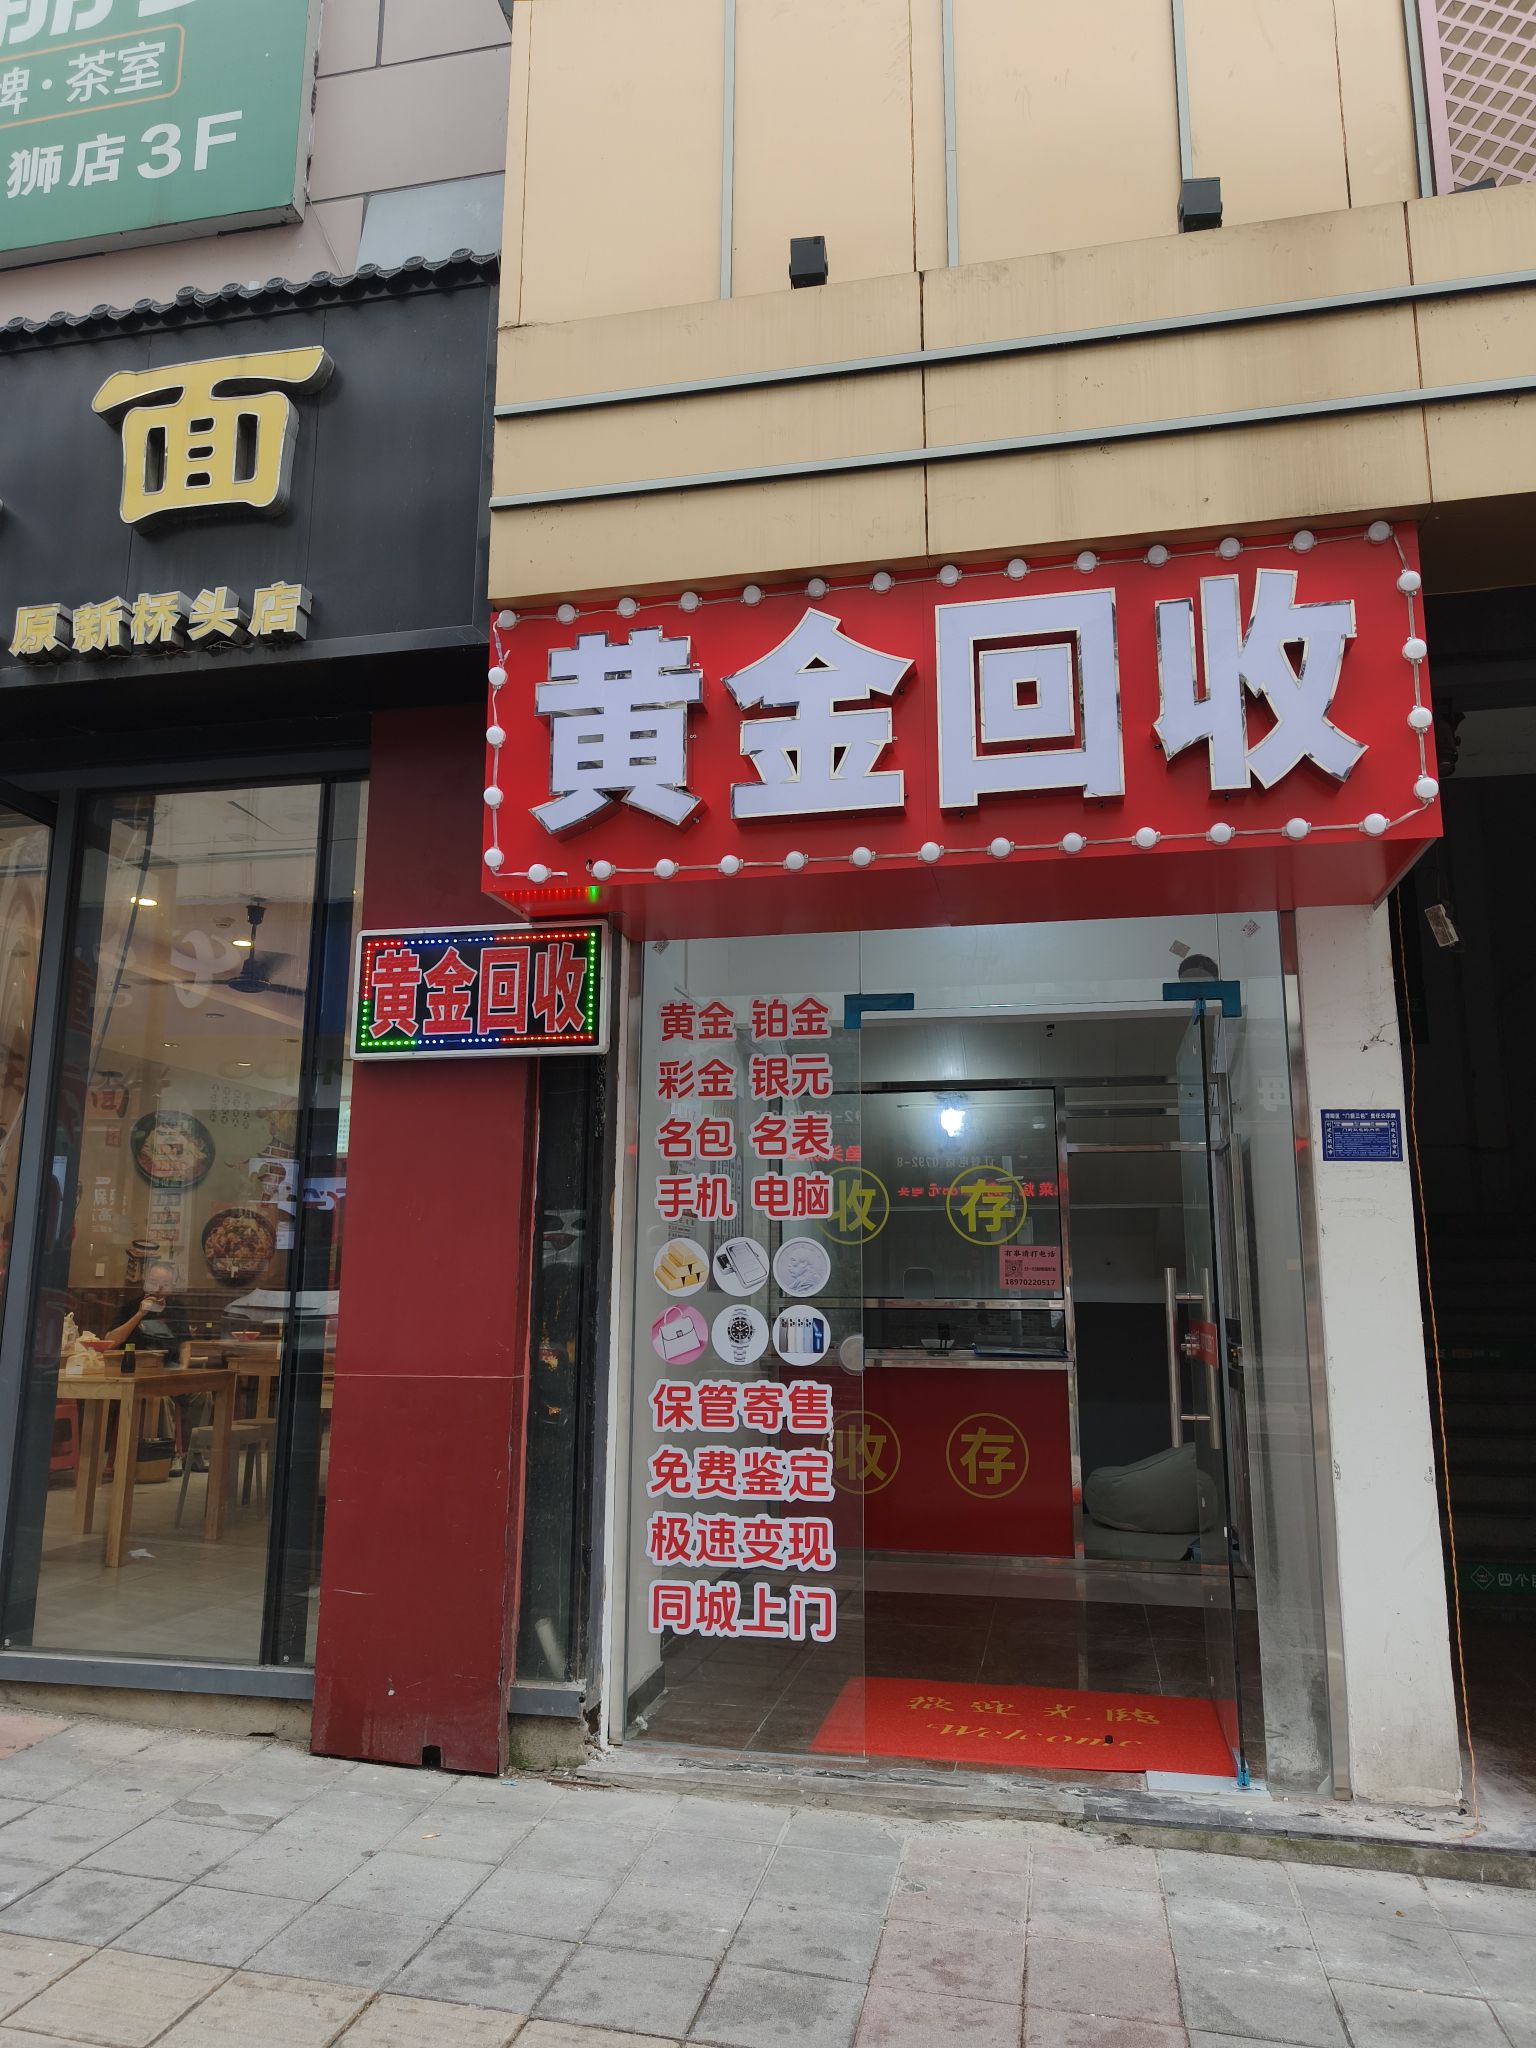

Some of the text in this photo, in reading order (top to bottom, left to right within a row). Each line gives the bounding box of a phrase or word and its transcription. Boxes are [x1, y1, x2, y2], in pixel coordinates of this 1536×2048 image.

[91, 345, 327, 524] 面
[8, 580, 302, 658] 原新桥头店
[528, 567, 1370, 837] 黄金回收
[369, 942, 588, 1038] 黄金回收
[659, 997, 829, 1042] 黄金 铂金
[657, 1056, 830, 1099] 彩金 银元
[657, 1117, 734, 1158] 名包
[751, 1114, 829, 1156] 名表
[657, 1175, 734, 1218] 手机
[753, 1174, 830, 1217] 电脑
[827, 1178, 1016, 1233] 收 存
[1005, 1278, 1056, 1286] 18970220517
[652, 1383, 829, 1430] 保管寄售
[651, 1449, 830, 1497] 免费鉴定
[834, 1423, 1016, 1485] 收 存
[650, 1515, 832, 1567] 极速变现
[652, 1584, 832, 1638] 同城上门
